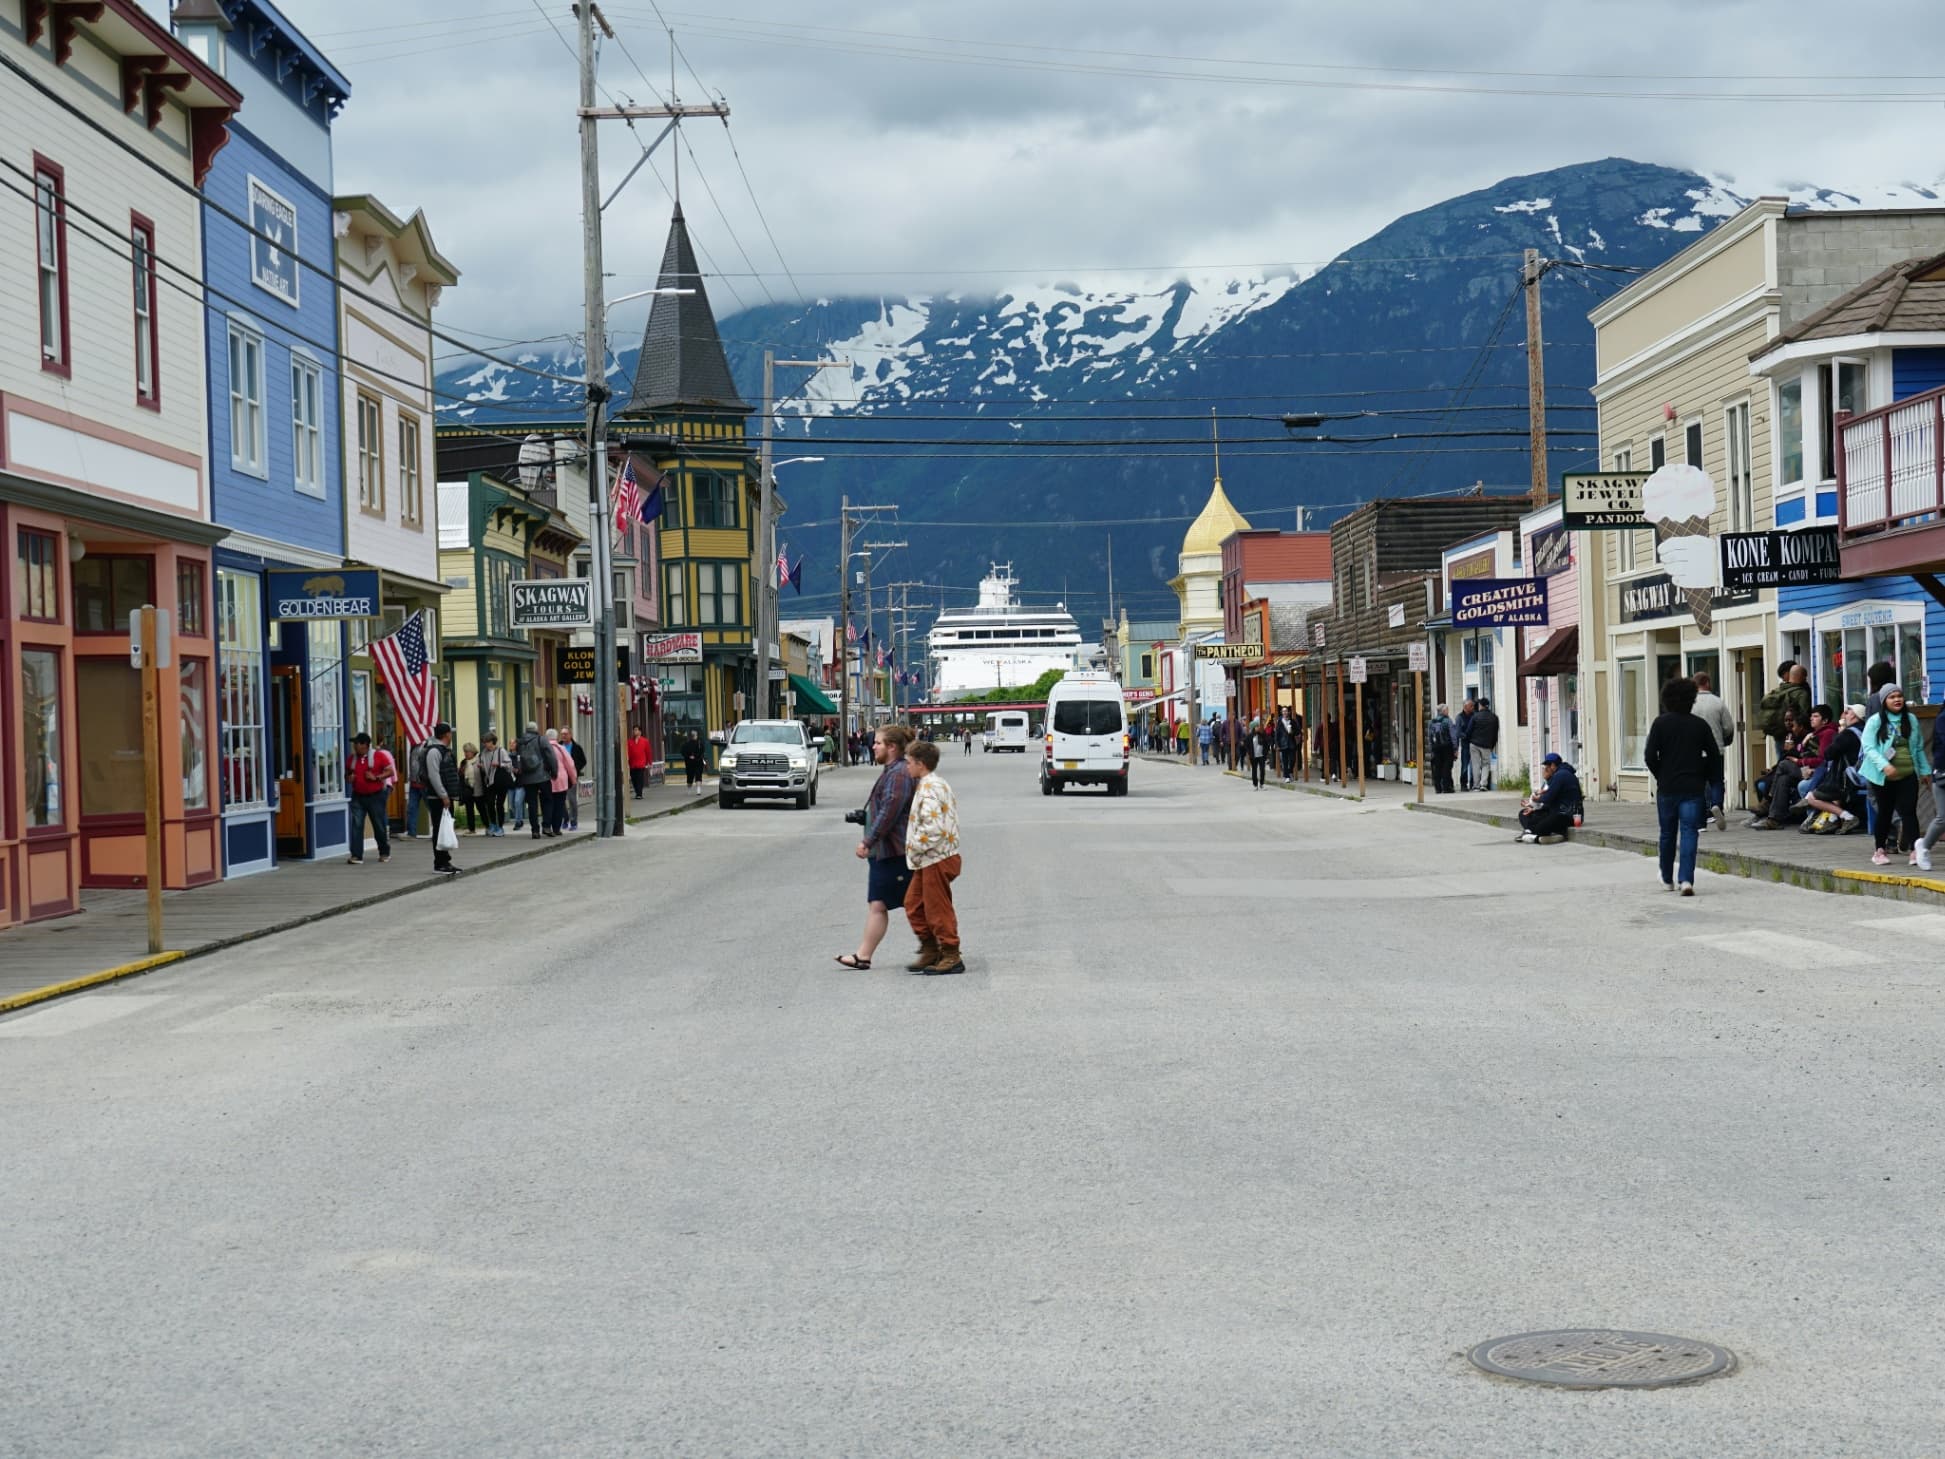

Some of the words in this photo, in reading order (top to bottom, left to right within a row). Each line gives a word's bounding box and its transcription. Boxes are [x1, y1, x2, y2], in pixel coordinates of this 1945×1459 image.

[1585, 514, 1645, 524] PANDOR
[1726, 536, 1770, 569] KONE
[1742, 573, 1753, 584] ICE
[1757, 571, 1779, 583] CREAM
[1788, 570, 1808, 580] CANDY
[515, 586, 587, 608] SKAGWAY
[1461, 583, 1536, 607] CREATIVE
[1624, 583, 1670, 612] SKAGWAY
[533, 604, 572, 614] TOURS
[1456, 594, 1544, 621] GOLDSMITH
[527, 615, 548, 623] ALASKA
[1493, 614, 1505, 622] OF
[1508, 613, 1542, 622] ALASKA
[646, 634, 699, 657] HARDWARE
[1207, 645, 1262, 657] PANTHEON
[564, 661, 591, 669] GOLD
